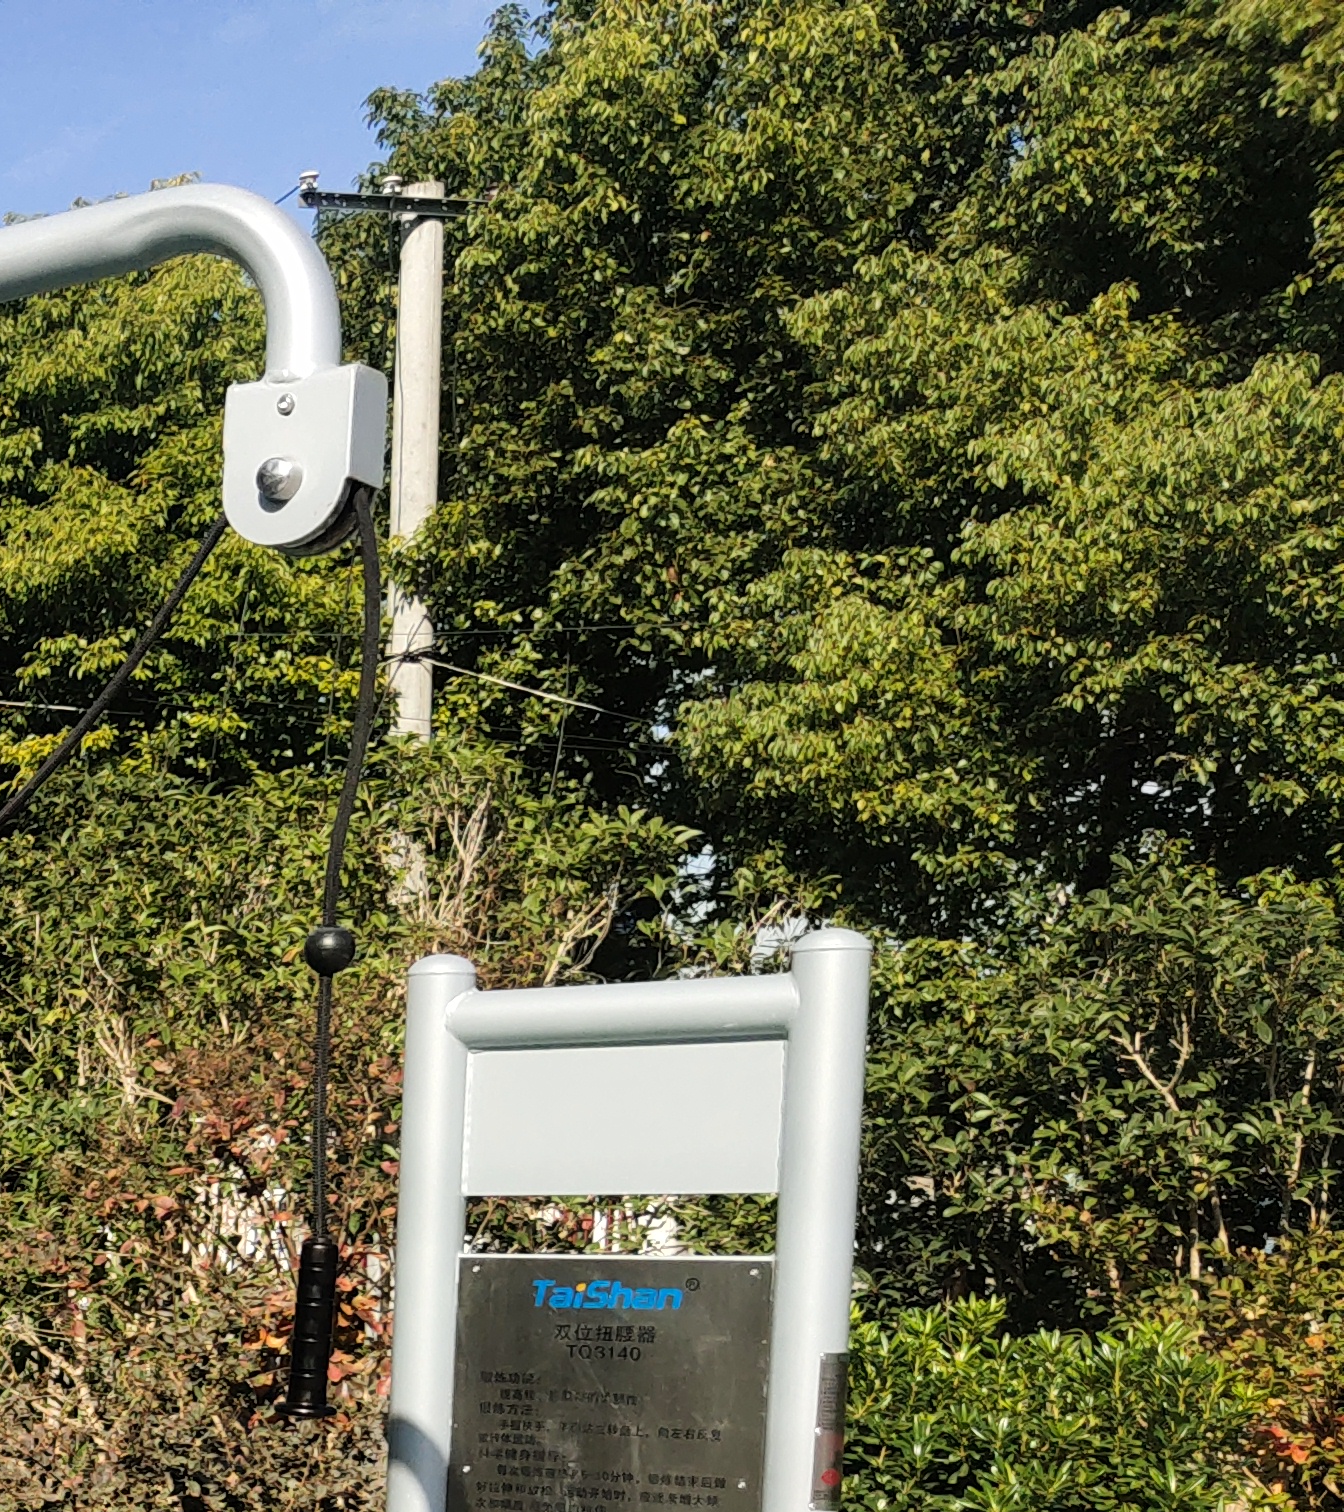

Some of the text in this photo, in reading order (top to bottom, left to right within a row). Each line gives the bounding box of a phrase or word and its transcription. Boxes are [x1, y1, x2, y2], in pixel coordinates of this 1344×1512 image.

[531, 1279, 683, 1311] TaiShan
[554, 1324, 657, 1344] 双位扭腰器
[566, 1345, 642, 1362] TQ3140
